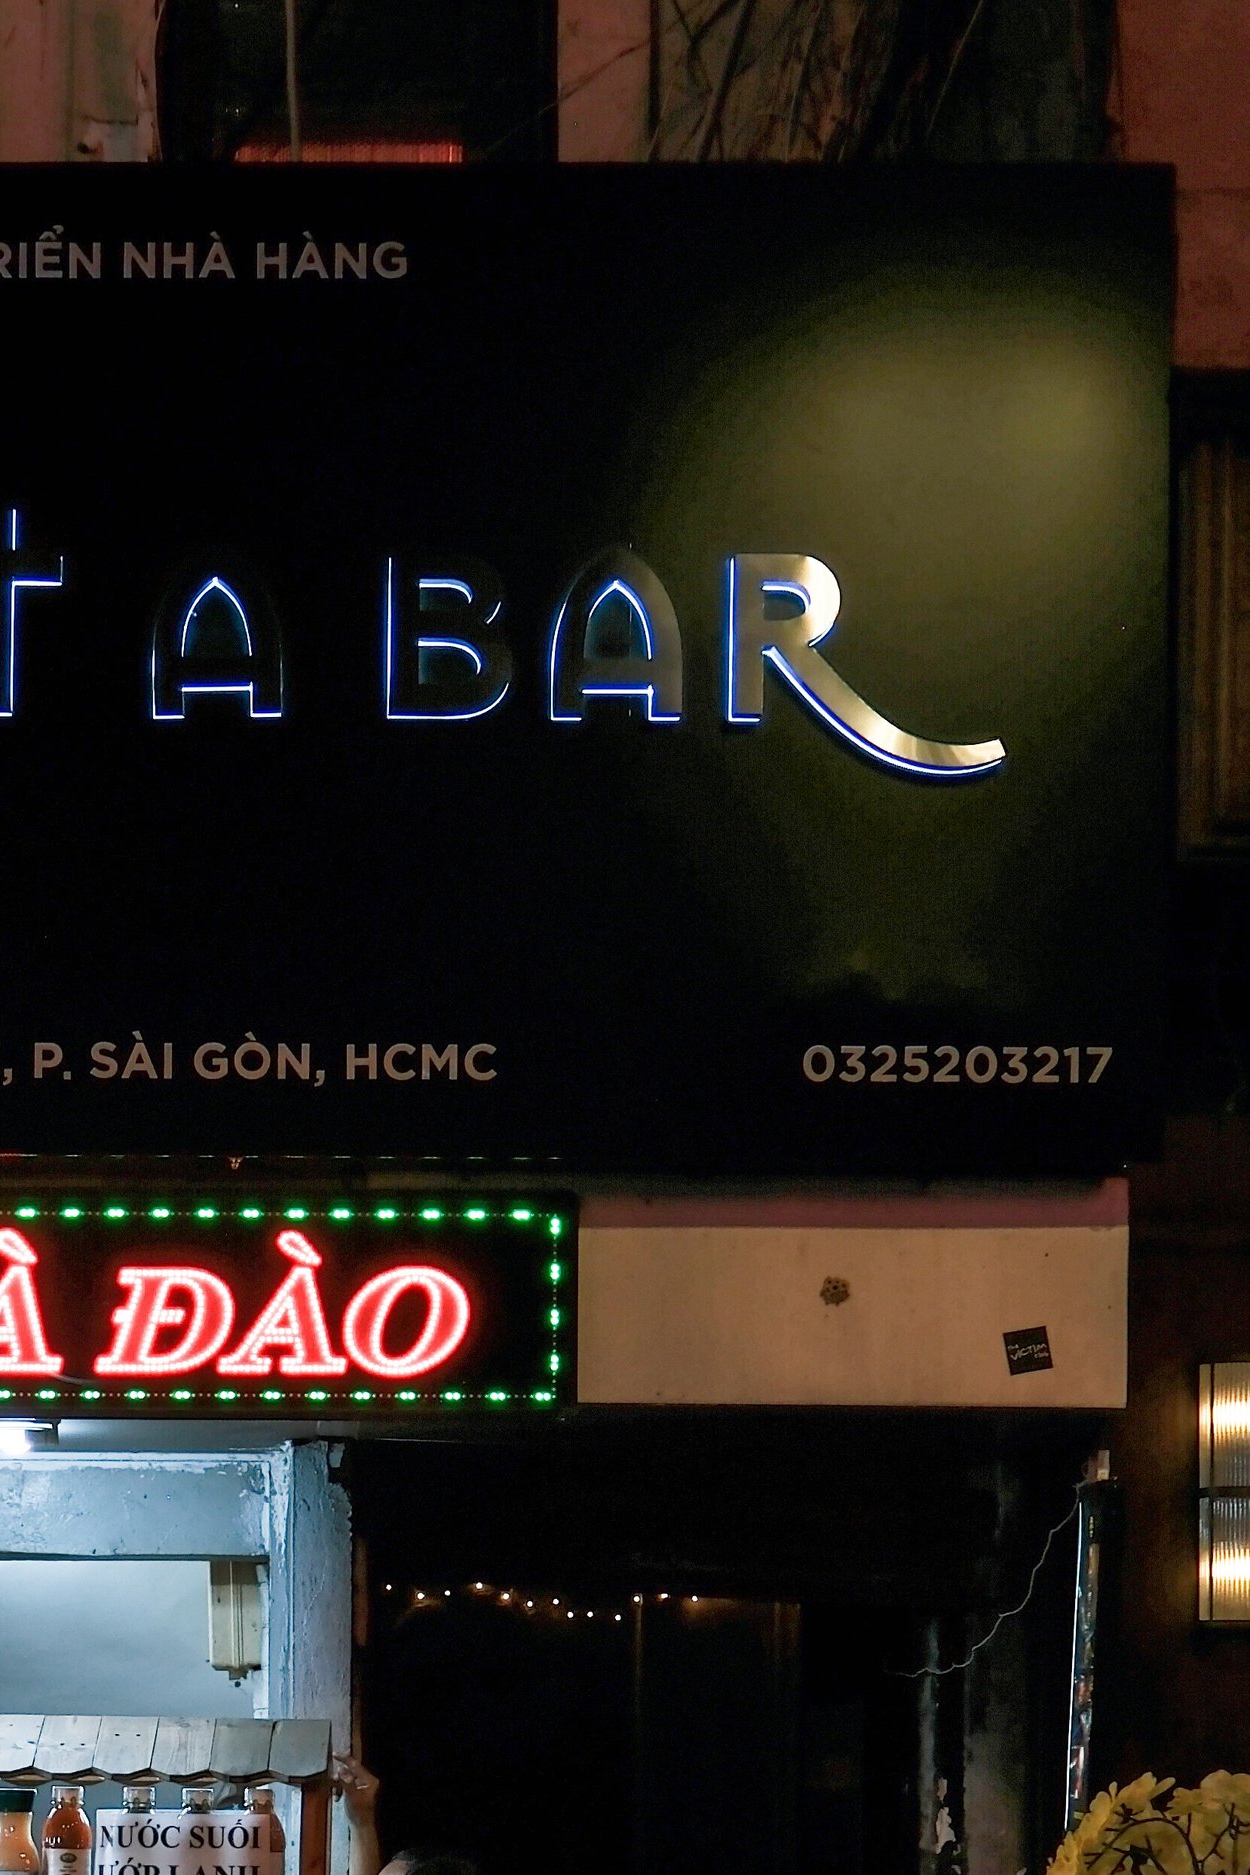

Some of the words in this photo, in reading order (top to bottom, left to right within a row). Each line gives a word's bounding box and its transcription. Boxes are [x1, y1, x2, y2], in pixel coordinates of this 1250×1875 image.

[122, 231, 237, 280] NHÀ
[255, 231, 409, 281] HÀNG
[384, 548, 1008, 780] BAR
[32, 1040, 73, 1082] P.
[88, 1029, 174, 1081] SÀI
[192, 1030, 327, 1089] GÒN,
[345, 1041, 499, 1082] HCMC
[801, 1043, 1114, 1086] 0325203217
[95, 1226, 473, 1380] ĐÀO
[98, 1820, 181, 1850] NƯỚC
[187, 1819, 262, 1850] SUỐI
